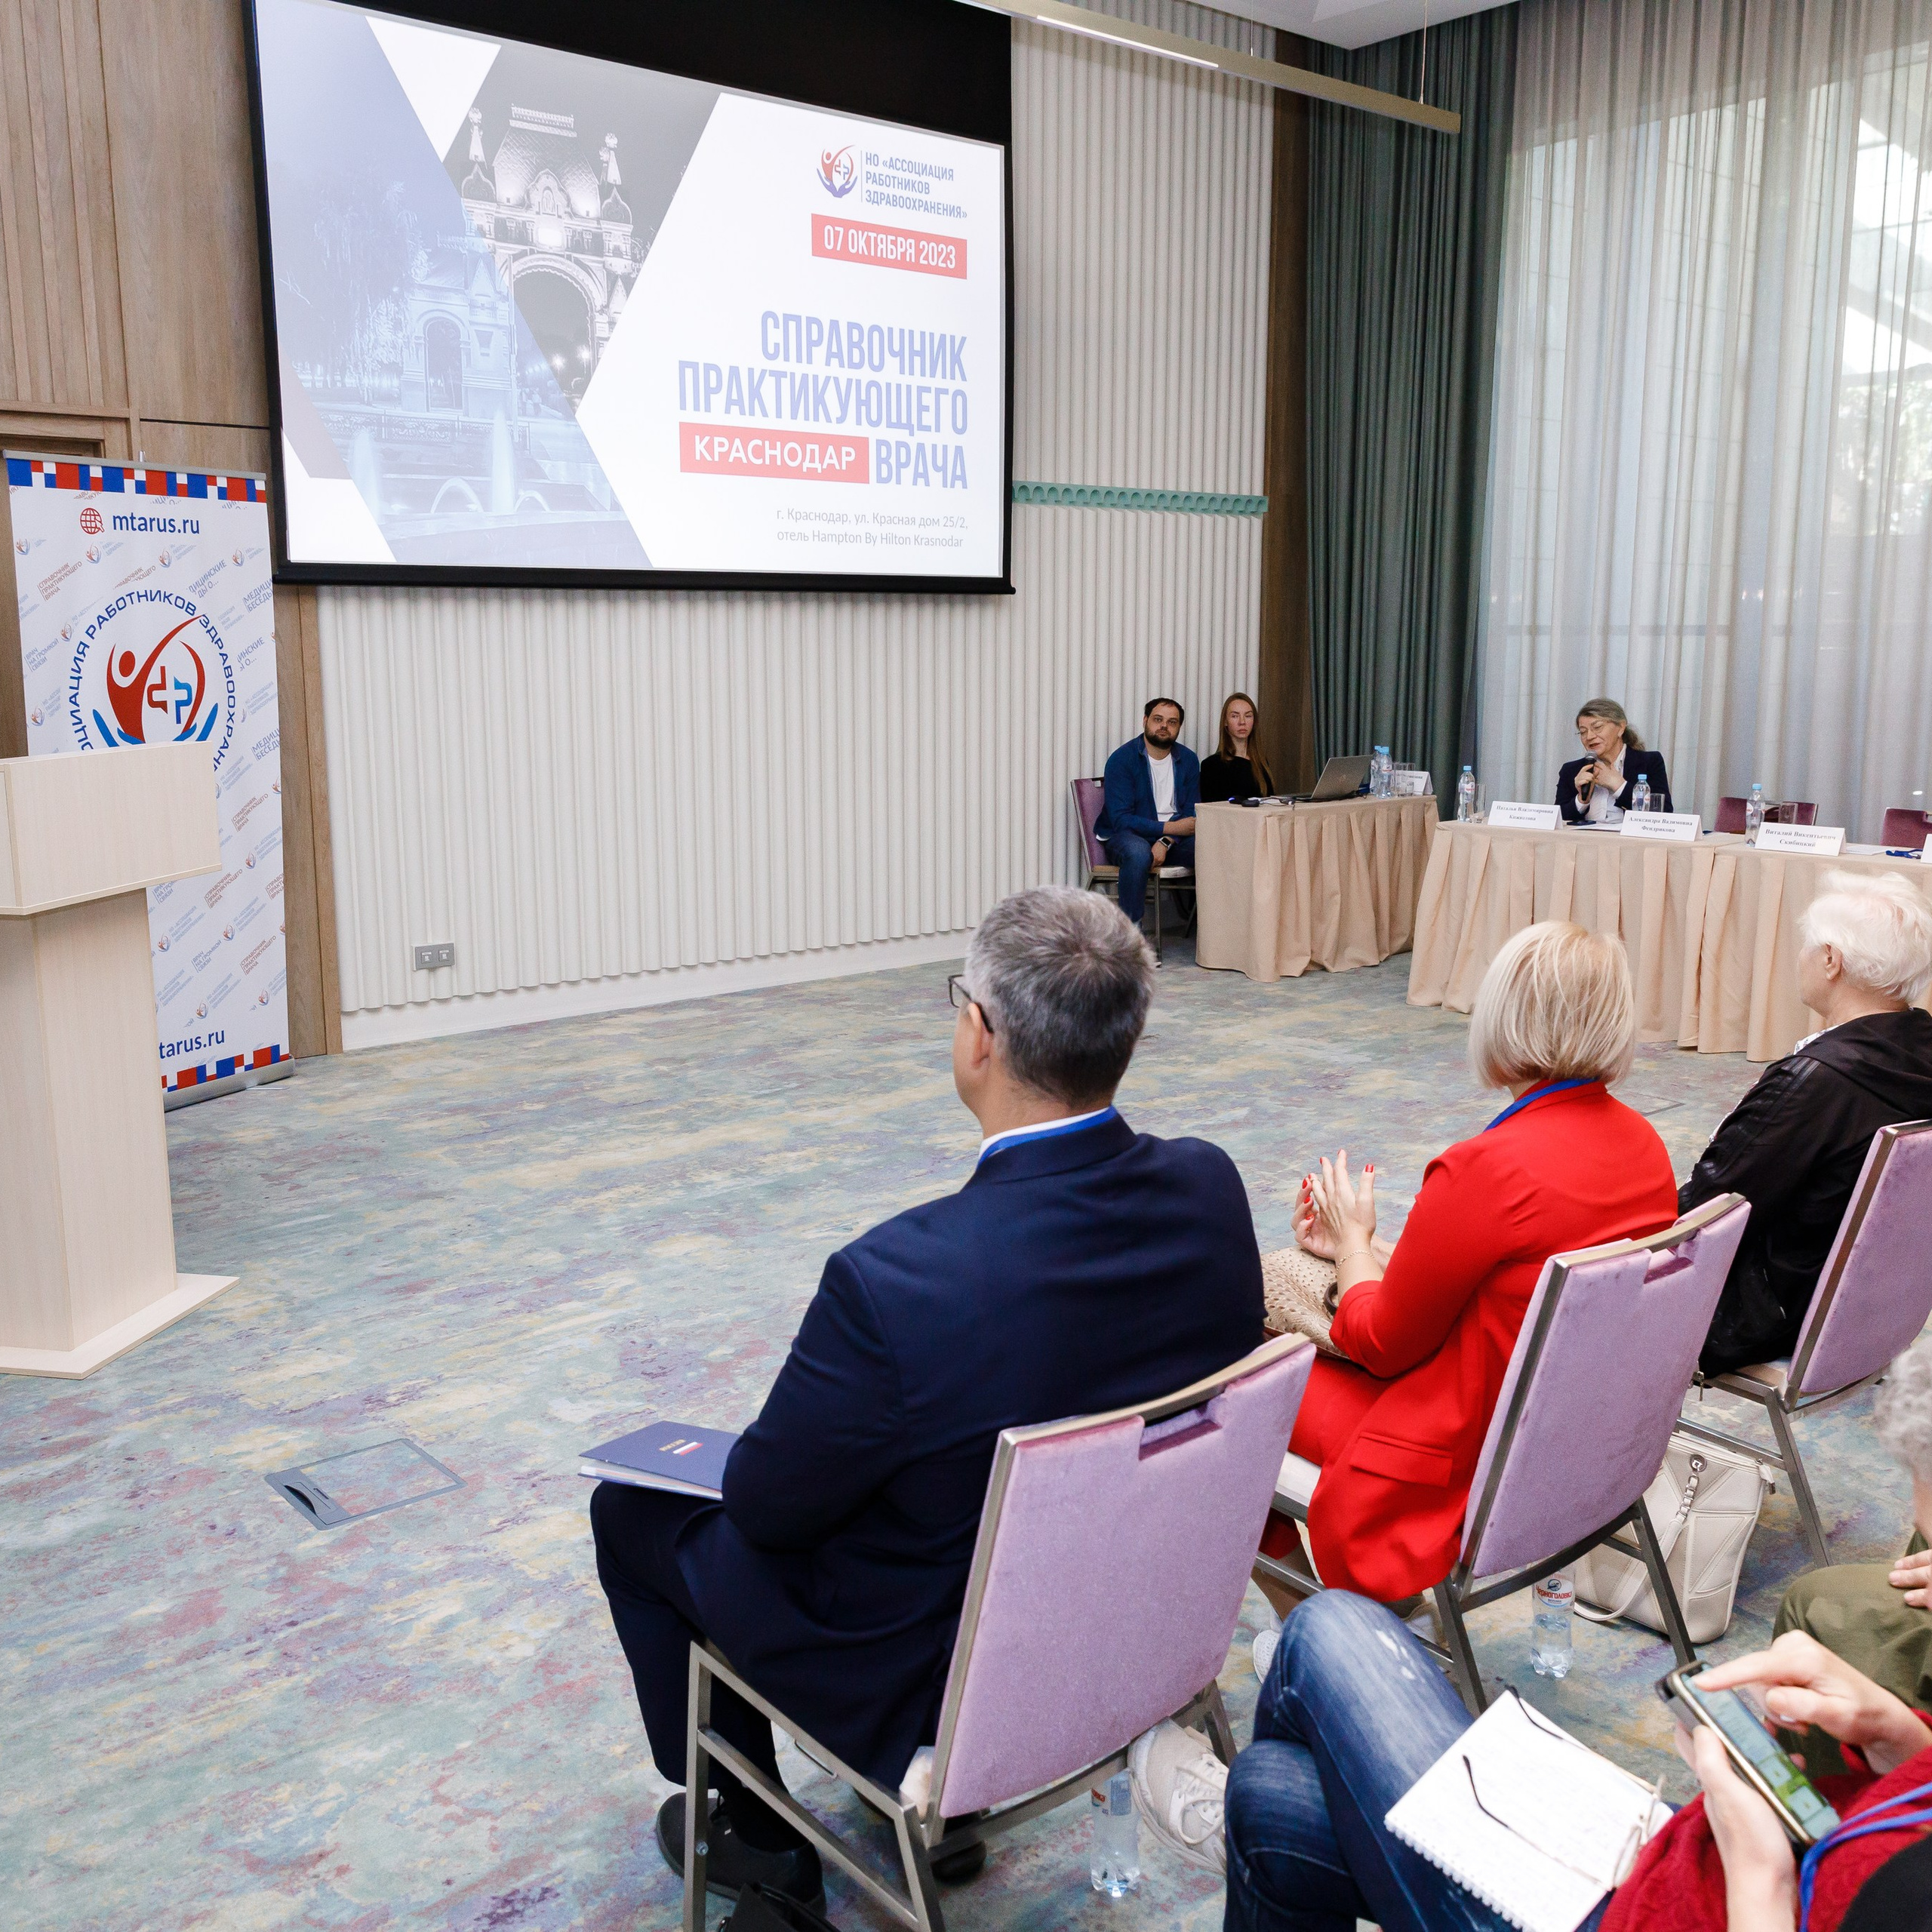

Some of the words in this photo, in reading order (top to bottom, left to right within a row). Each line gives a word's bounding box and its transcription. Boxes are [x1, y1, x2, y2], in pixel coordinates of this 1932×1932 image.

[866, 152, 879, 168] НО
[882, 156, 954, 182] «АССОЦИАЦИЯ
[866, 171, 931, 195] РАБОТНИКОВ
[865, 189, 968, 219] ЗДРАВООХРАНЕНИЯ»
[823, 224, 844, 251] 07
[848, 229, 915, 263] ОКТЯБРЯ
[919, 240, 956, 269] 2023
[761, 310, 968, 382] СПРАВОЧНИК
[678, 359, 968, 437] ПРАКТИКУЮЩЕГО
[694, 435, 856, 473] КРАСНОДАР
[875, 438, 968, 490] ВРАЧА
[112, 512, 200, 534] mtarus.ru
[777, 509, 784, 520] г.
[787, 507, 851, 525] Краснодар,
[854, 513, 869, 526] ул.
[872, 512, 915, 527] Красная
[918, 516, 940, 529] дом
[777, 531, 809, 542] отель
[812, 530, 862, 546] Hampton
[865, 532, 877, 546] By
[880, 533, 911, 546] Hilton
[914, 534, 964, 547] Krasnodar
[38, 562, 70, 589] СПРАВОЧНИК
[42, 561, 82, 595] ПРАКТИКУЮЩЕГО
[45, 586, 60, 601] ВРАЧА
[85, 589, 197, 640] РАБОТНИКОВ
[232, 795, 257, 822] СПРАВОЧНИК
[205, 872, 232, 899] СПРАВОЧНИК
[266, 873, 284, 891] СПРАВО
[210, 894, 223, 909] ВРАЧА
[241, 940, 266, 966] СПРАВОЧНИК
[245, 961, 259, 975] ВРАЧА
